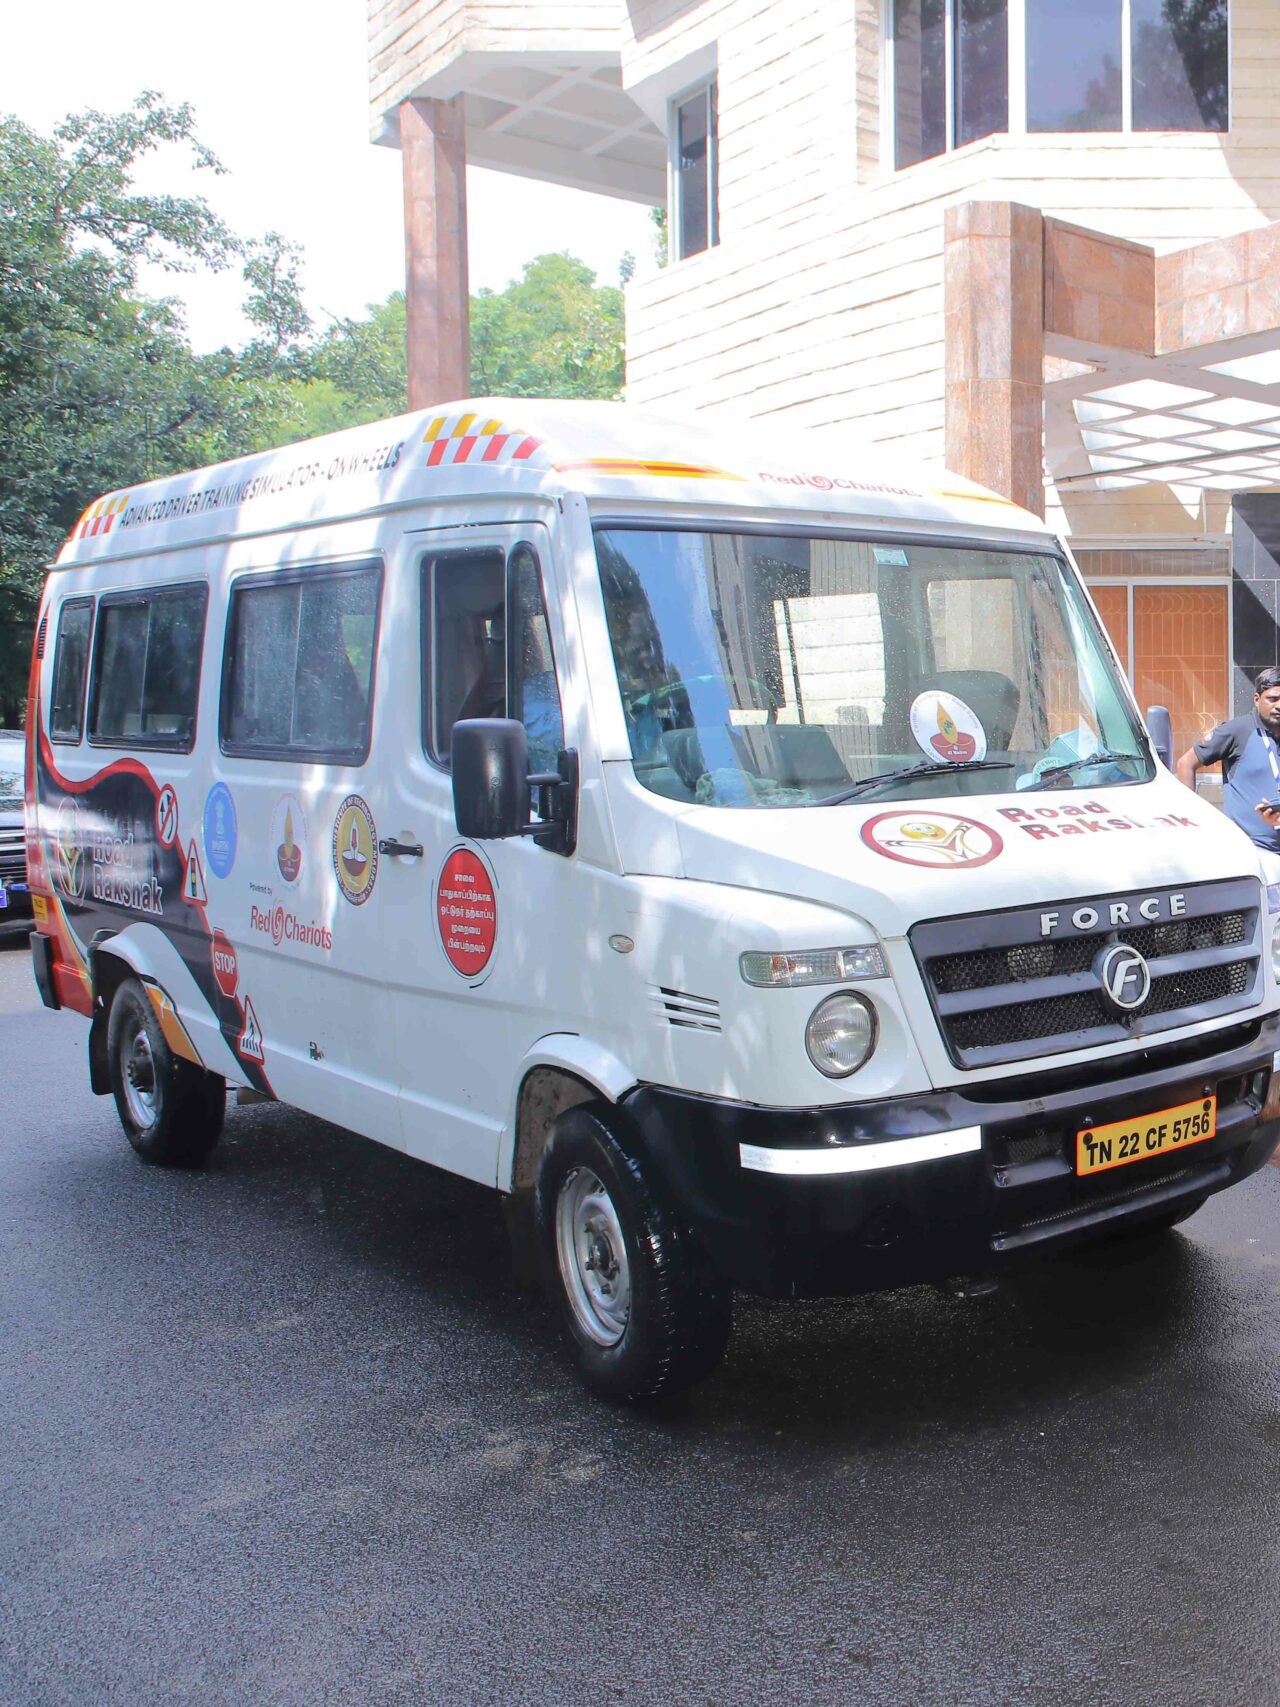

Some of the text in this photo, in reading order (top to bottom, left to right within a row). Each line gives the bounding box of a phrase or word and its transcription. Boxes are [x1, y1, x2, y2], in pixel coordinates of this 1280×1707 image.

[164, 492, 202, 518] DRIVER
[248, 462, 321, 500] SIMULATOR
[348, 442, 405, 477] WHEELS
[996, 799, 1111, 823] Road
[94, 832, 134, 868] Road
[93, 864, 164, 915] Rakshak
[250, 905, 333, 950] Red Chariots
[1040, 894, 1186, 936] FORCE
[214, 952, 236, 975] STOP
[1086, 1112, 1210, 1167] TN 22 CF 5756
